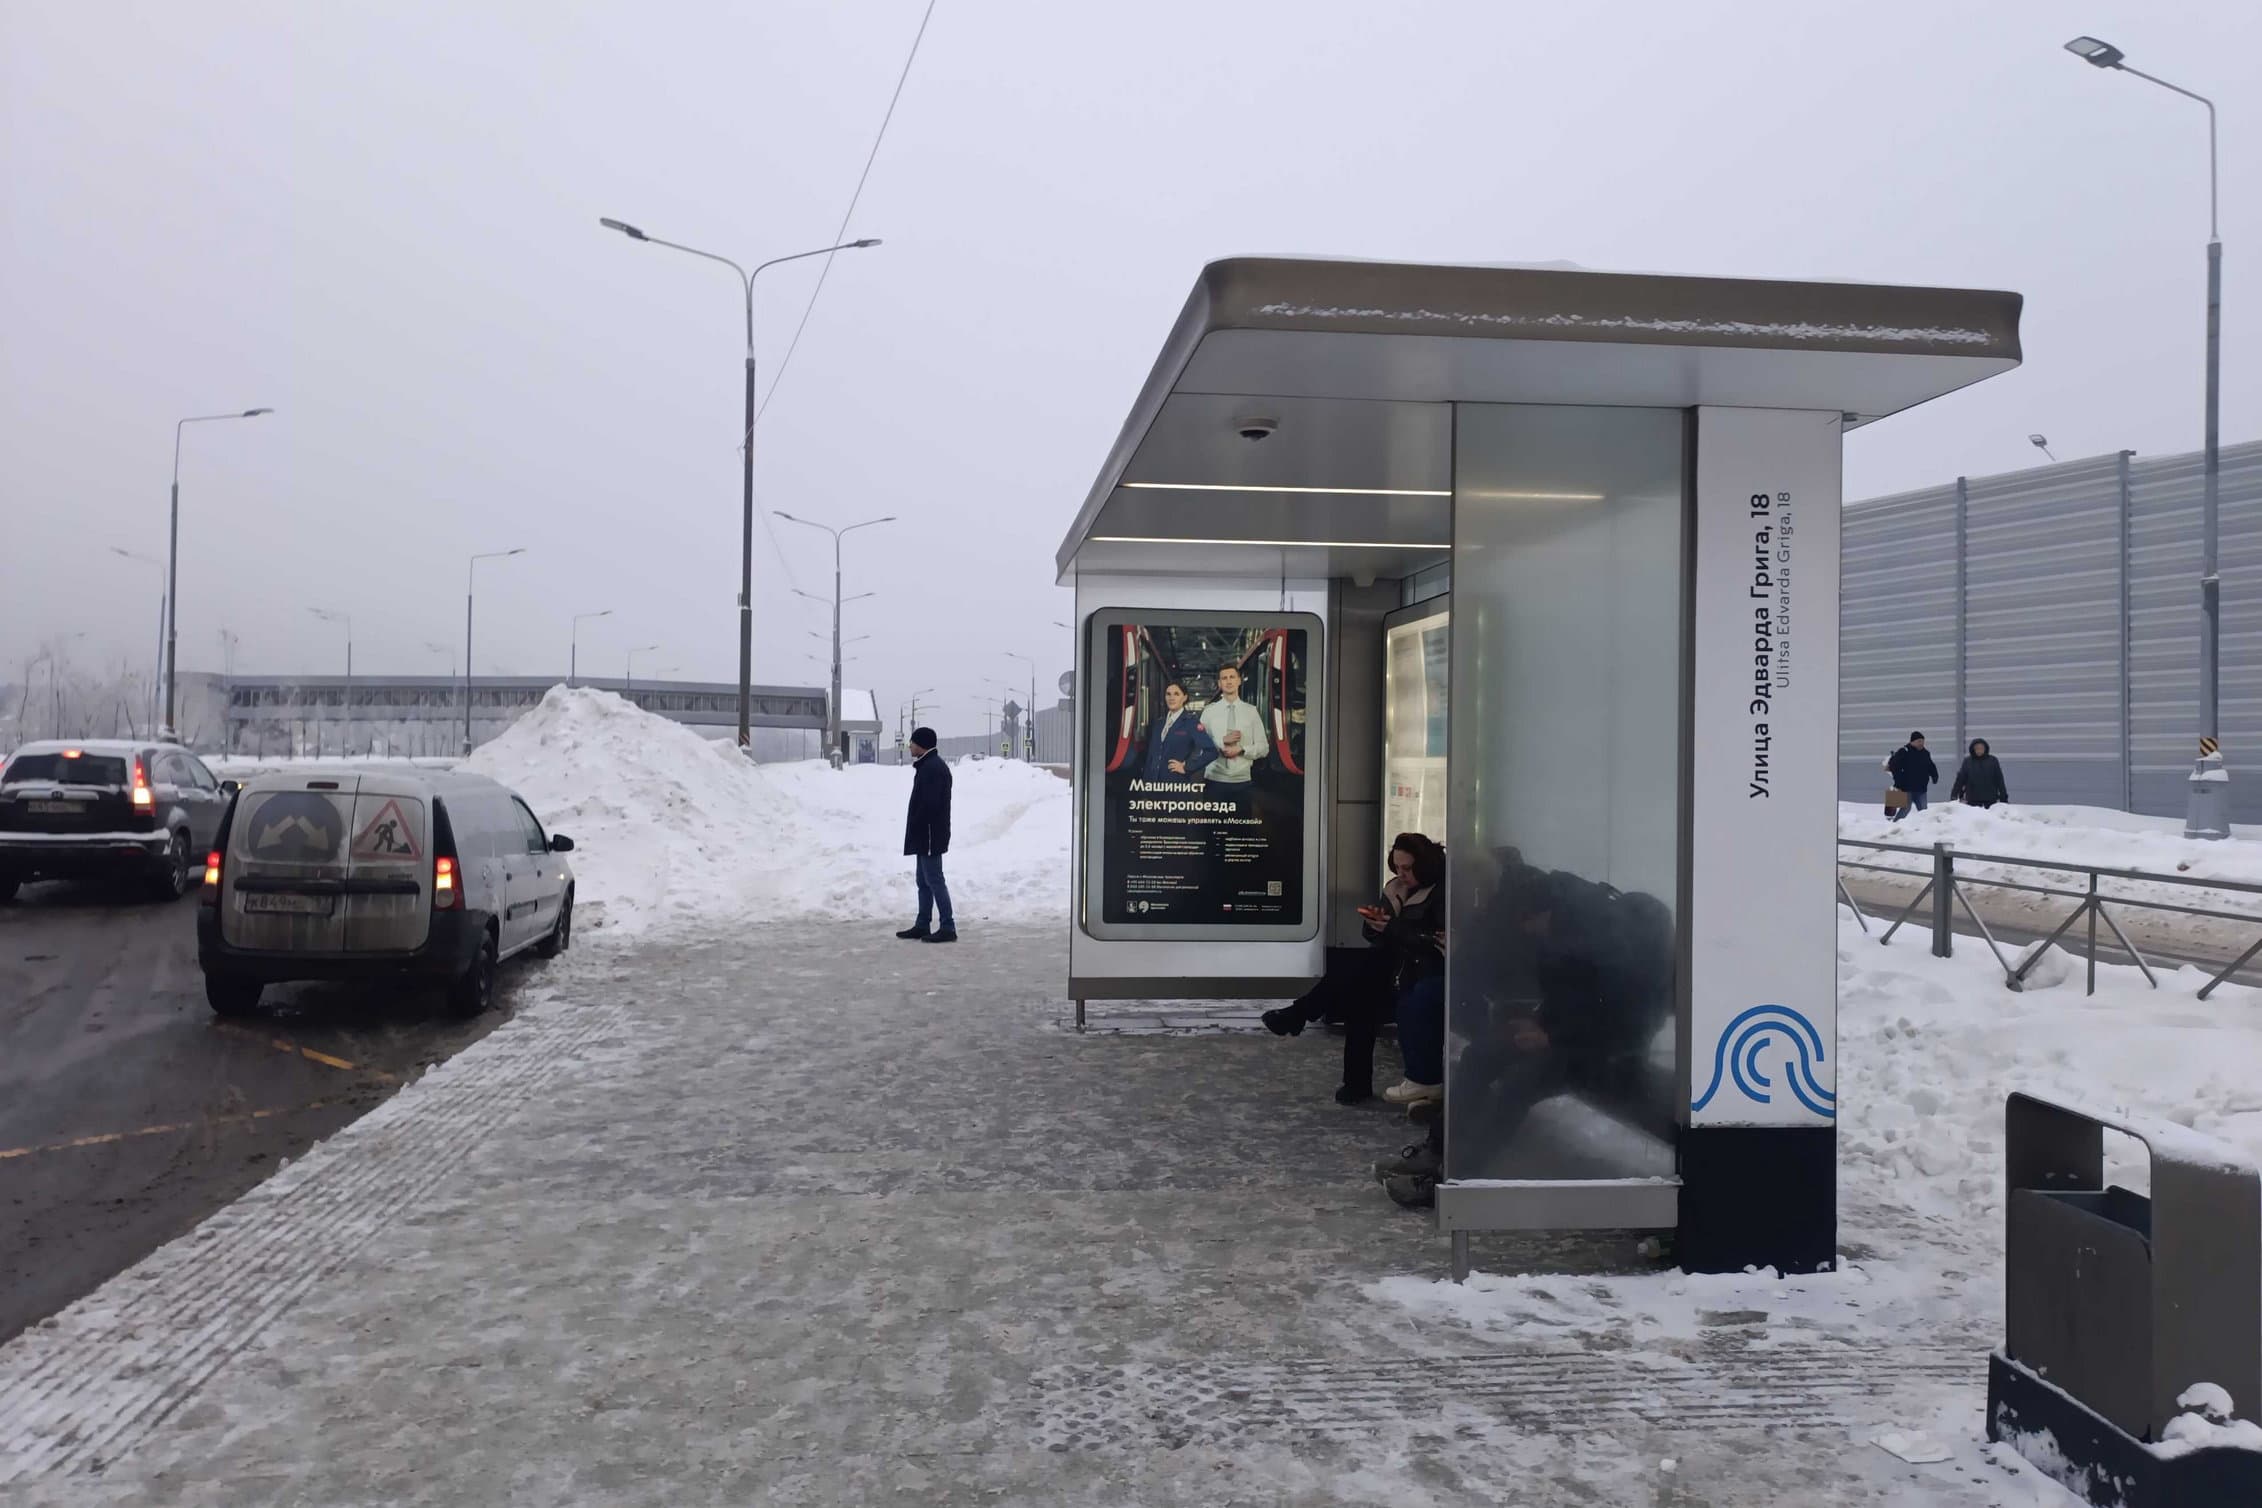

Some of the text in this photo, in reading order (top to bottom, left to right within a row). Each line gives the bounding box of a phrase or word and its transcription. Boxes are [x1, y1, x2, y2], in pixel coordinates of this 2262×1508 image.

[1776, 492, 1793, 688] Ulitsa Edvarda Griga, 18
[1750, 494, 1773, 798] Улица Эдварда Грига, 18
[1129, 778, 1206, 793] Машинист
[1128, 800, 1237, 813] электропоезда
[1128, 815, 1138, 823] Ты
[1187, 817, 1222, 825] управлять
